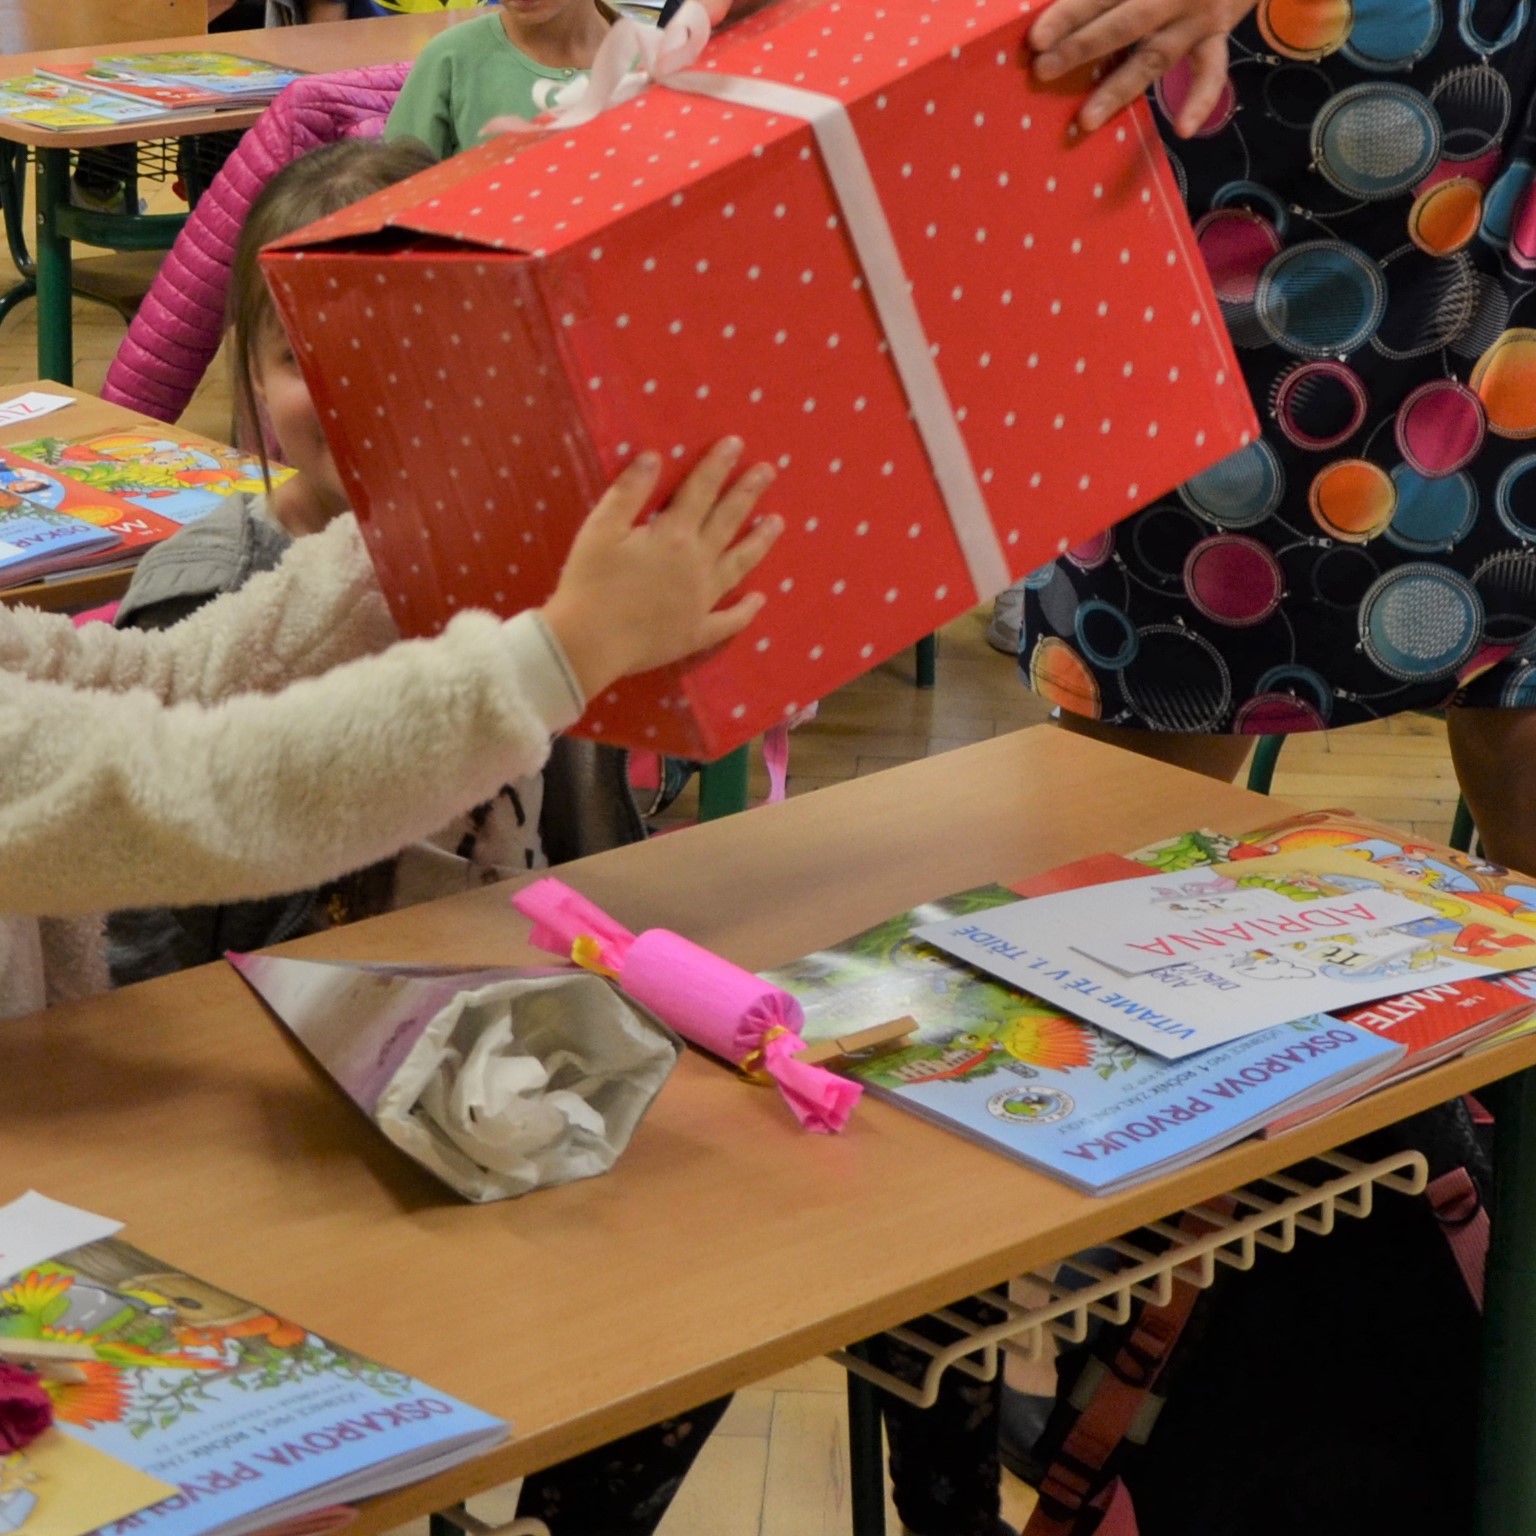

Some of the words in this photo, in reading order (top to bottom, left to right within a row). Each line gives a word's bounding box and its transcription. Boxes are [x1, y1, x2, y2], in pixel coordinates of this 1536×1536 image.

[1126, 903, 1377, 957] ADRIANA
[1101, 994, 1199, 1041] VÍTÁME
[1347, 979, 1462, 1031] MATE
[1203, 1028, 1358, 1099] OSKAROVA
[1062, 1095, 1214, 1161] PRVOUKA
[253, 1397, 454, 1467] OSKAROVA
